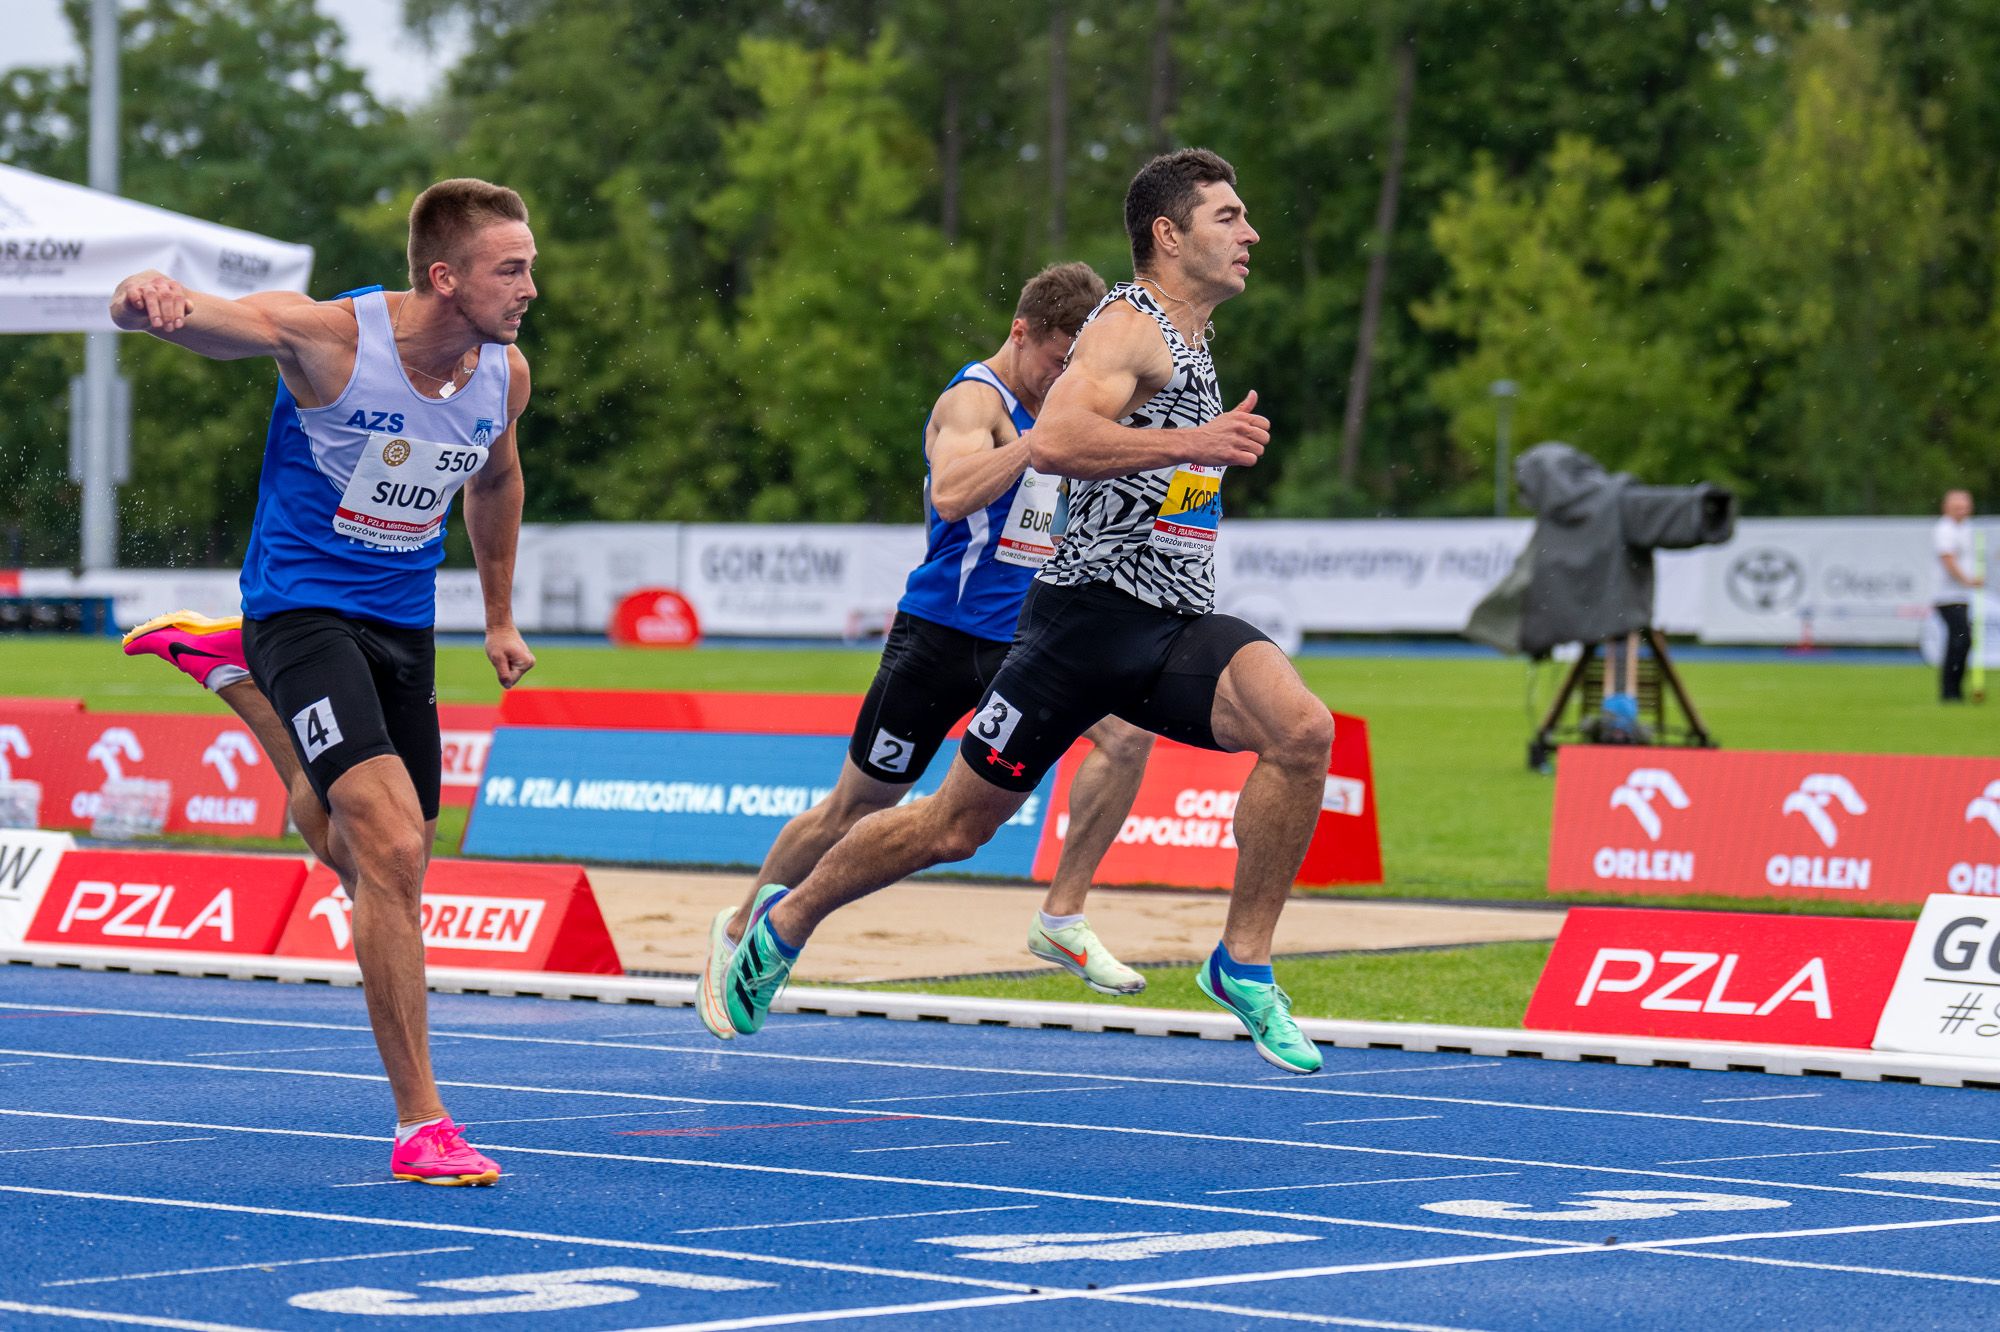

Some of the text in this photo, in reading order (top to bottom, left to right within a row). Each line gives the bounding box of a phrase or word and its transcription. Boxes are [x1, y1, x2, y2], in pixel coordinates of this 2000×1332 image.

[346, 410, 405, 433] AZS
[435, 451, 478, 472] 550
[371, 481, 446, 511] SIUDA
[1180, 487, 1219, 515] KOPE
[338, 521, 378, 537] GORZÓW
[354, 514, 366, 523] 99.
[367, 517, 385, 528] PZLA
[1019, 508, 1053, 533] BUR
[1167, 525, 1177, 534] 99.
[1001, 550, 1027, 560] GORZÓW
[1155, 535, 1182, 546] GORZÓW
[699, 540, 848, 584] GORZÓW
[307, 707, 329, 747] 4
[978, 702, 1008, 740] 3
[877, 739, 903, 769] 2
[186, 794, 258, 825] ORLEN
[486, 776, 517, 807] 99.
[520, 777, 572, 809] PZLA
[574, 780, 726, 815] MISTRZOSTWA
[726, 784, 809, 817] POLSKI
[1593, 847, 1694, 882] ORLEN
[1766, 854, 1871, 890] ORLEN
[57, 880, 235, 942] PZLA
[1575, 948, 1833, 1020] PZLA
